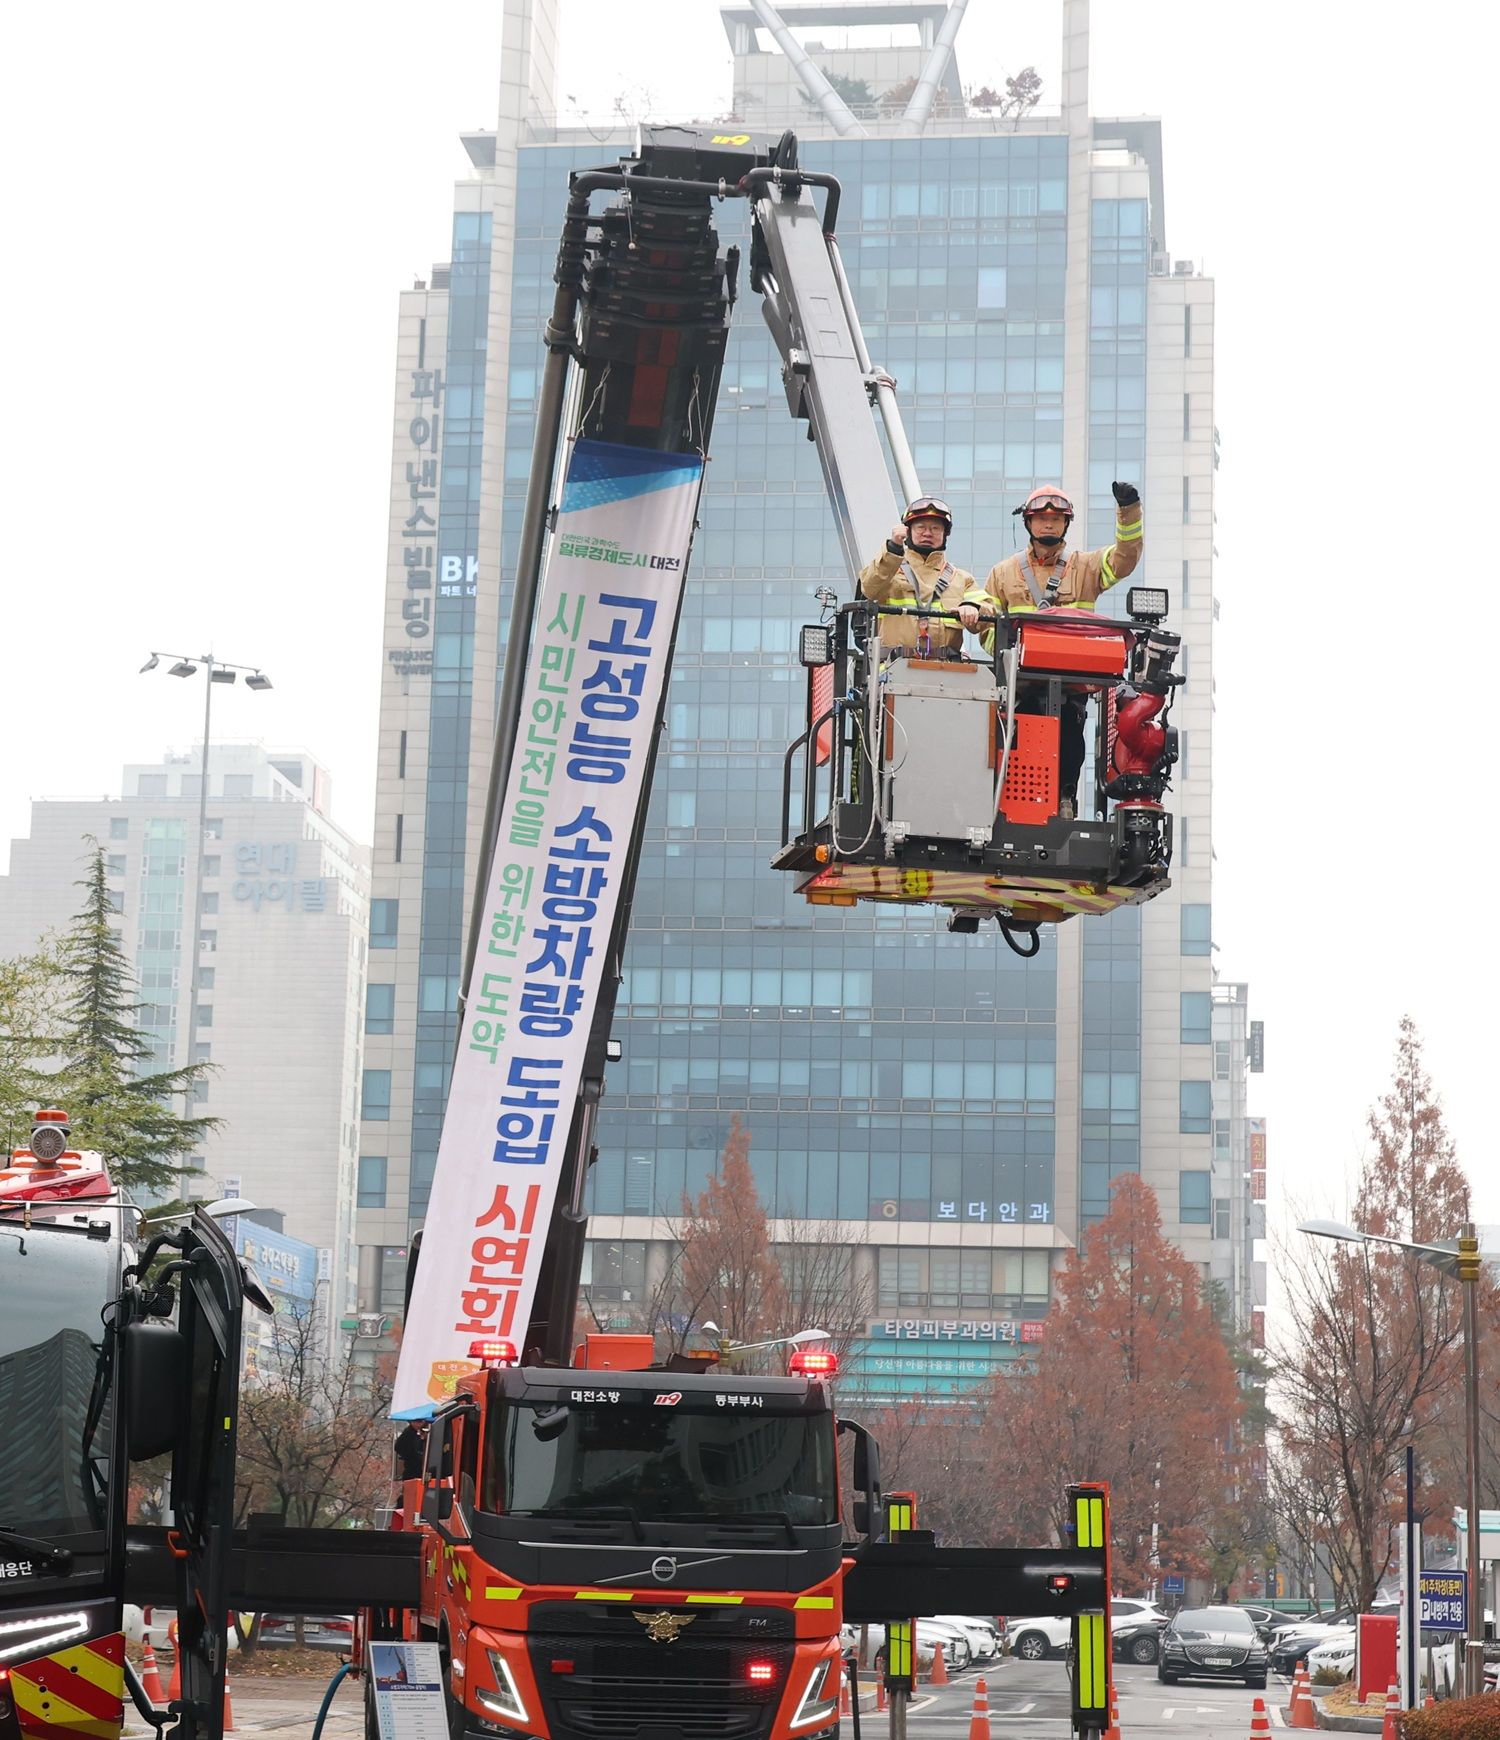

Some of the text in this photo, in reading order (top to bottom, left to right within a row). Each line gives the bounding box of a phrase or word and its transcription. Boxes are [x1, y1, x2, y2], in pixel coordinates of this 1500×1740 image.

[402, 368, 446, 638] 파이낸스빌딩
[559, 542, 680, 571] 일류경제도시 대전
[469, 592, 586, 1064] 시민안전을 위한 도약
[455, 592, 657, 1337] 고성능 소방차량 도입 시연회
[937, 1201, 1050, 1223] 보다안과
[885, 1319, 1016, 1342] 타임피부과의원
[571, 1391, 620, 1403] 대전소방
[653, 1391, 682, 1406] 119
[1450, 1601, 1462, 1622] 전용
